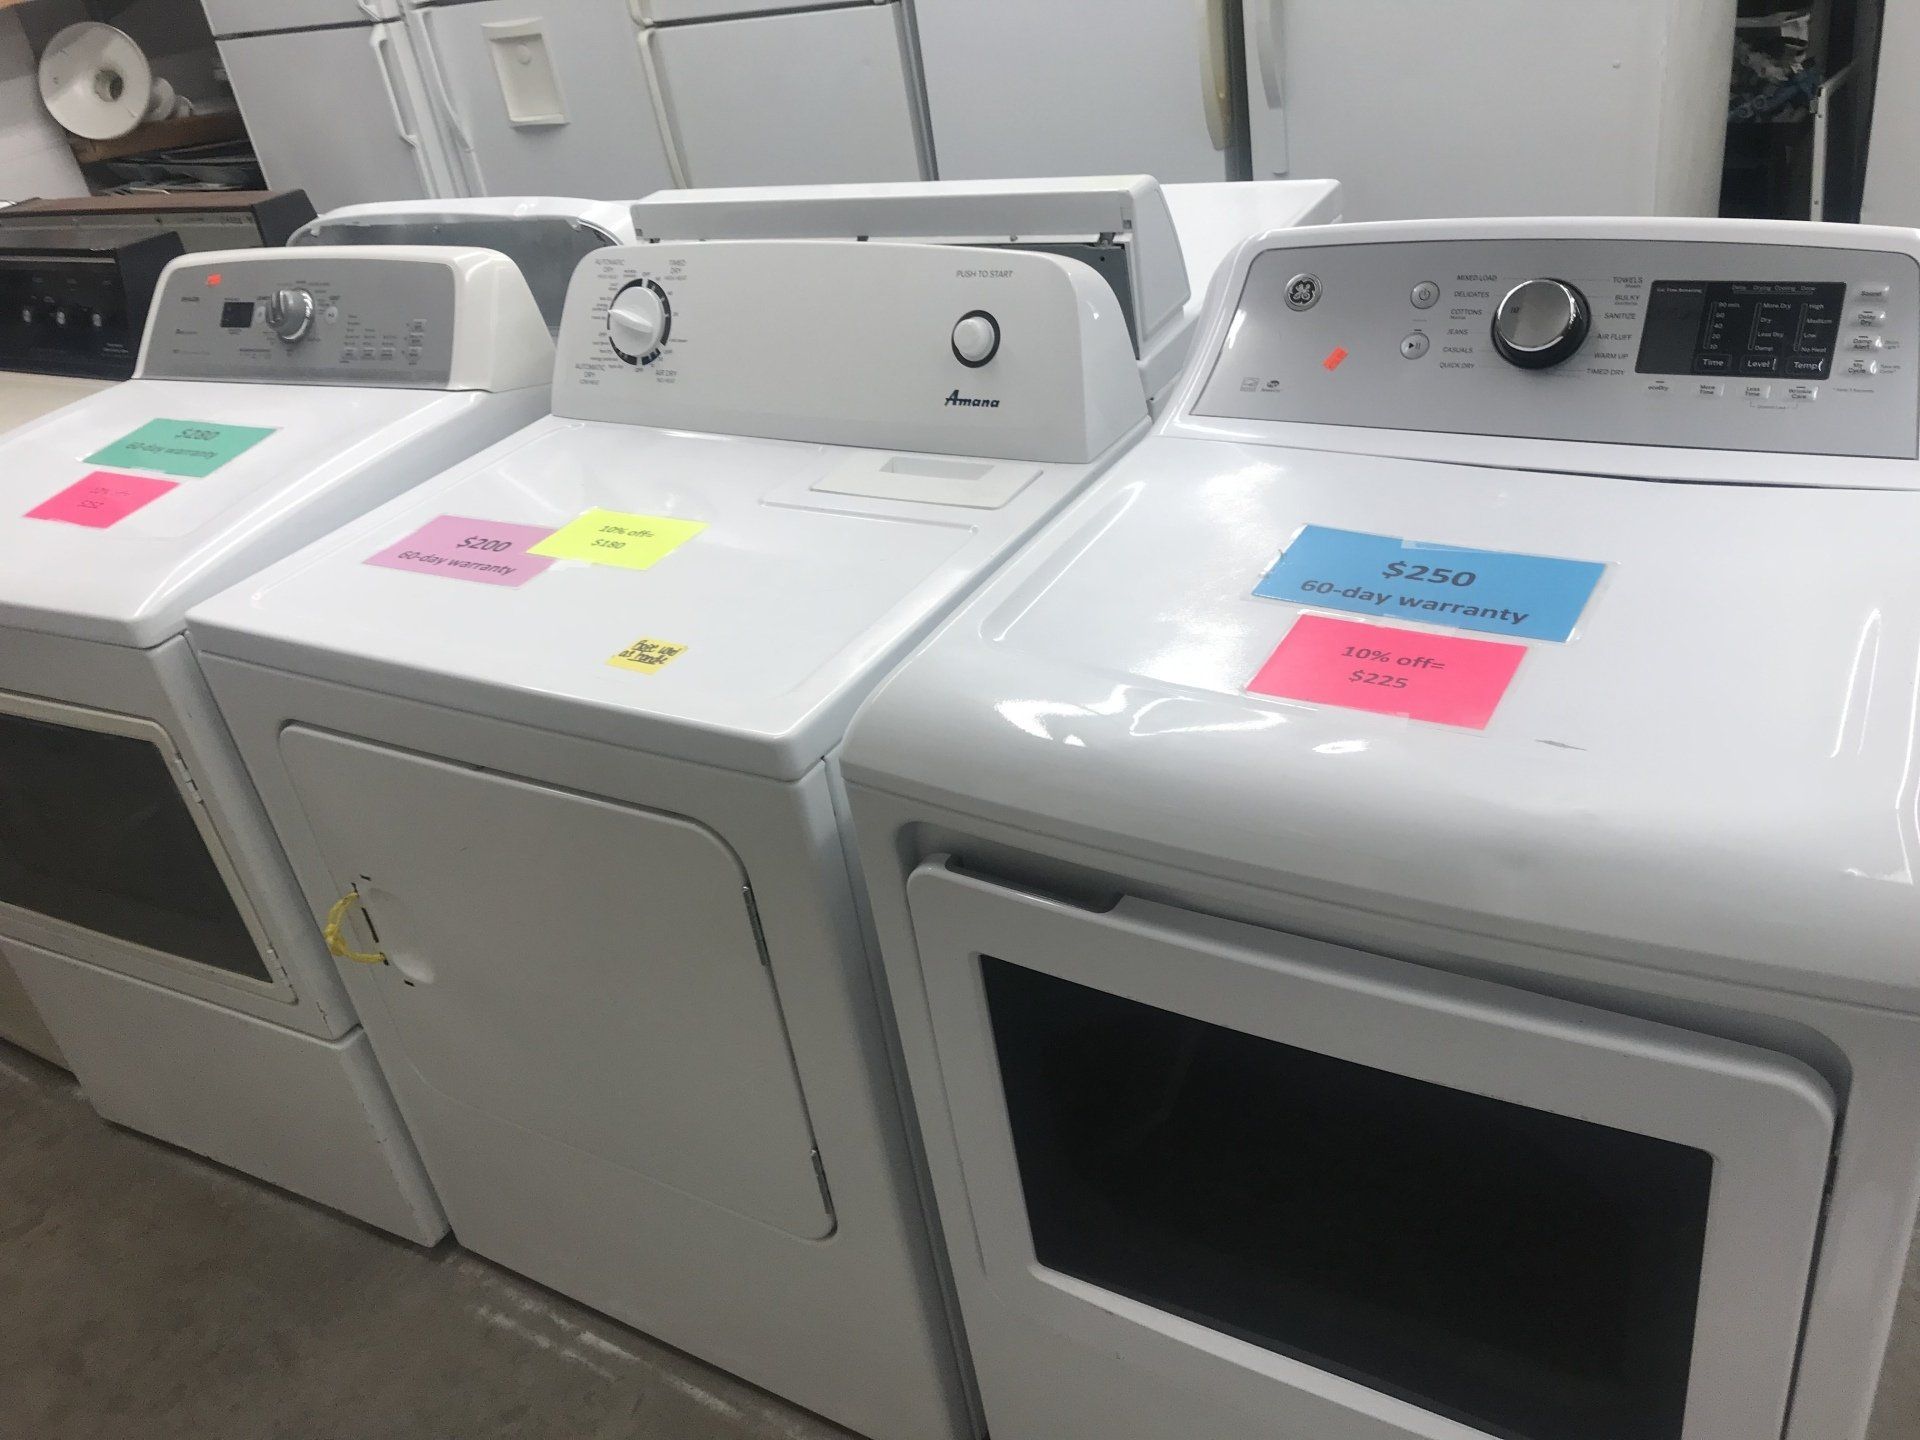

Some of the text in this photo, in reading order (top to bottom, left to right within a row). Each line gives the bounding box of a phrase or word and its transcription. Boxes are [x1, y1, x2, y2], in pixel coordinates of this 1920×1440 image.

[956, 270, 1014, 278] PUSH TO START
[1613, 276, 1643, 284] TOWELS
[1454, 290, 1490, 298] DELICATES
[1780, 302, 1792, 310] Dry
[1450, 308, 1483, 316] COTTONS
[1603, 312, 1637, 320] SANITIZE
[1446, 328, 1469, 336] JEANS
[1772, 331, 1785, 339] Dry
[1597, 333, 1633, 341] AIR FLUFF
[1442, 346, 1473, 354] CASUALS
[1594, 351, 1629, 361] WARM UP
[1439, 362, 1475, 370] QUICK DRY
[1703, 358, 1724, 367] Time
[1747, 359, 1770, 368] Level
[1793, 361, 1818, 371] Temp
[1586, 368, 1625, 377] TIMED DRY
[944, 389, 1000, 408] Amana
[598, 525, 655, 539] 10% off=
[455, 535, 513, 553] $200
[590, 538, 627, 551] $180
[398, 550, 517, 577] 60-day warranty
[1381, 560, 1478, 588] $250
[1300, 578, 1531, 626] 60-day warranty
[1341, 645, 1447, 672] 10% off=
[1347, 669, 1409, 690] $225
